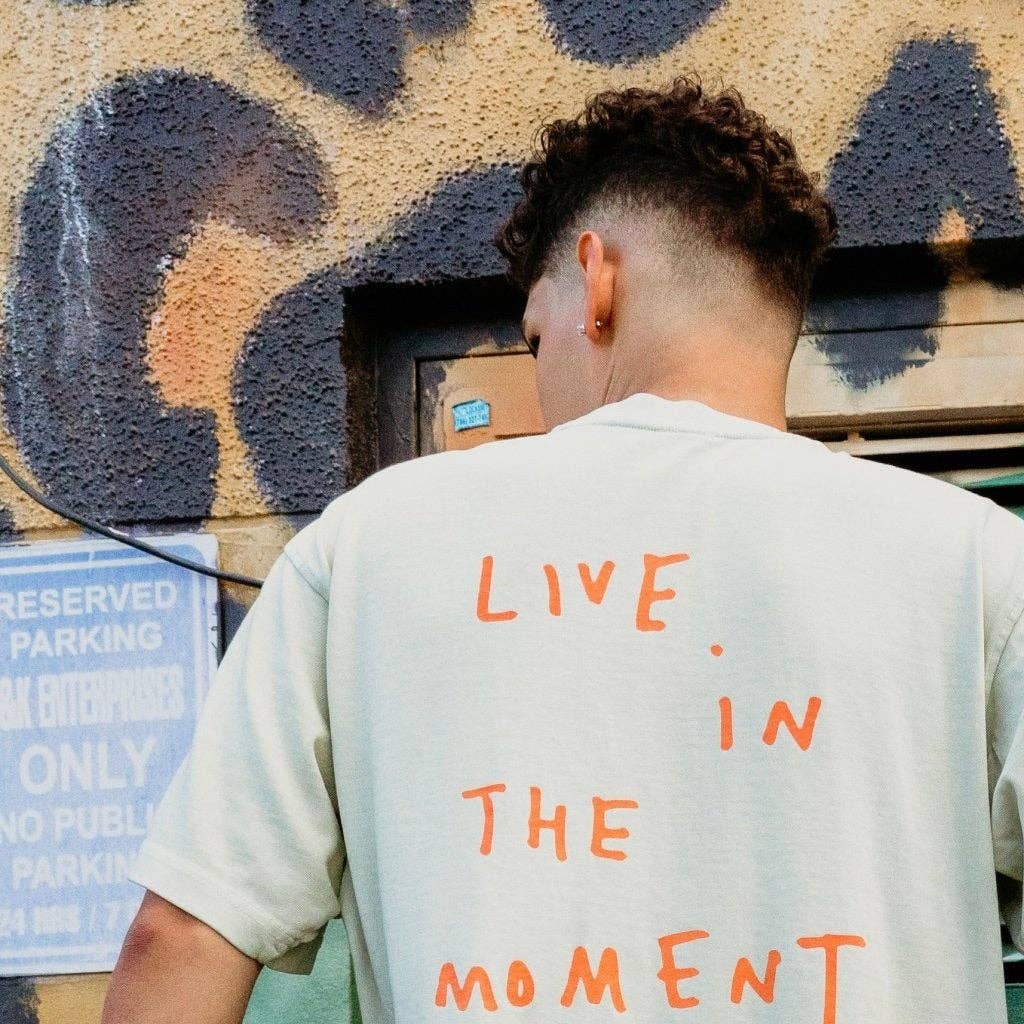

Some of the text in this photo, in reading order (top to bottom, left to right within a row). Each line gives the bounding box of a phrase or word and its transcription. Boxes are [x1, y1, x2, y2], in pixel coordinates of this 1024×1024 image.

[0, 580, 178, 621] RESERVED
[476, 552, 690, 632] LIVE
[10, 621, 164, 661] PARKING
[718, 695, 822, 752] IN
[19, 738, 159, 796] ONLY
[0, 802, 156, 844] NO PUBLI
[462, 782, 640, 862] THE
[12, 851, 137, 891] PARKIN
